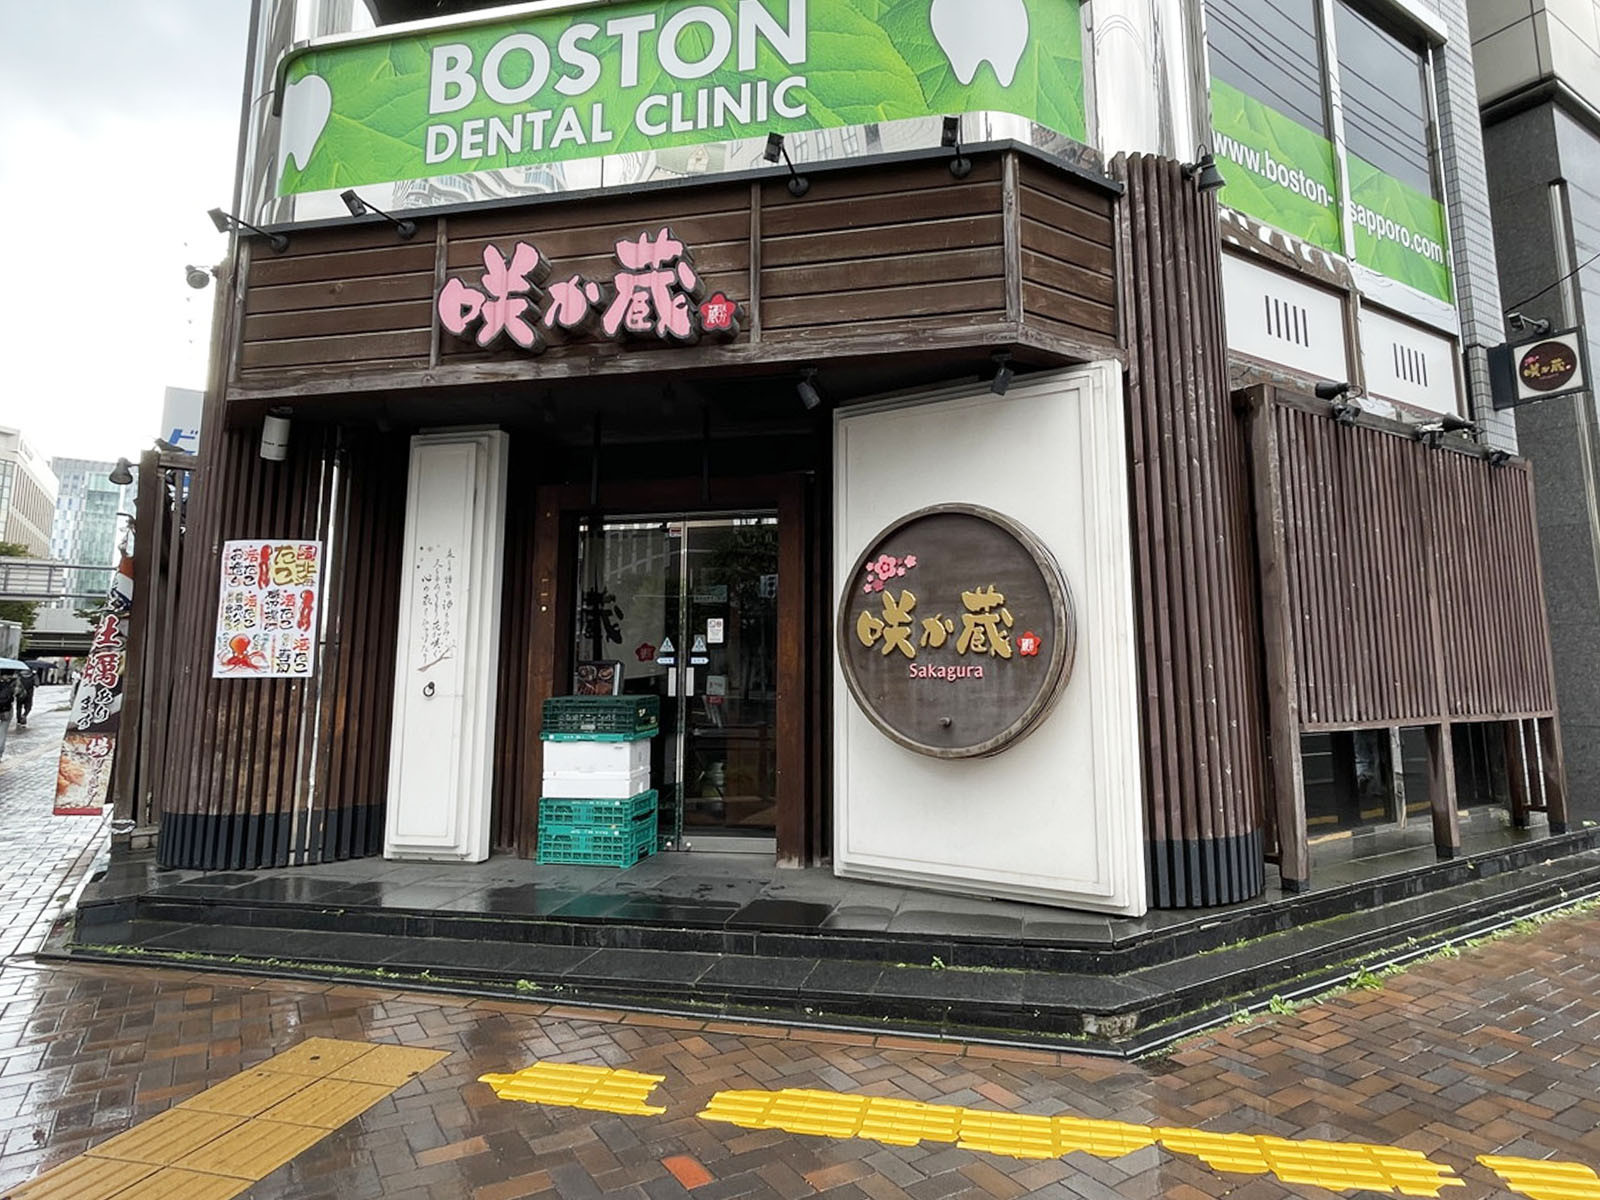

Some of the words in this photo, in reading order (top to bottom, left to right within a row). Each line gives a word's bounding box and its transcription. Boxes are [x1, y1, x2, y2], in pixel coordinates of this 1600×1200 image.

[428, 0, 806, 114] BOSTON
[425, 103, 612, 164] DENTAL
[635, 76, 806, 136] CLINIC
[909, 663, 984, 681] Sakagura
